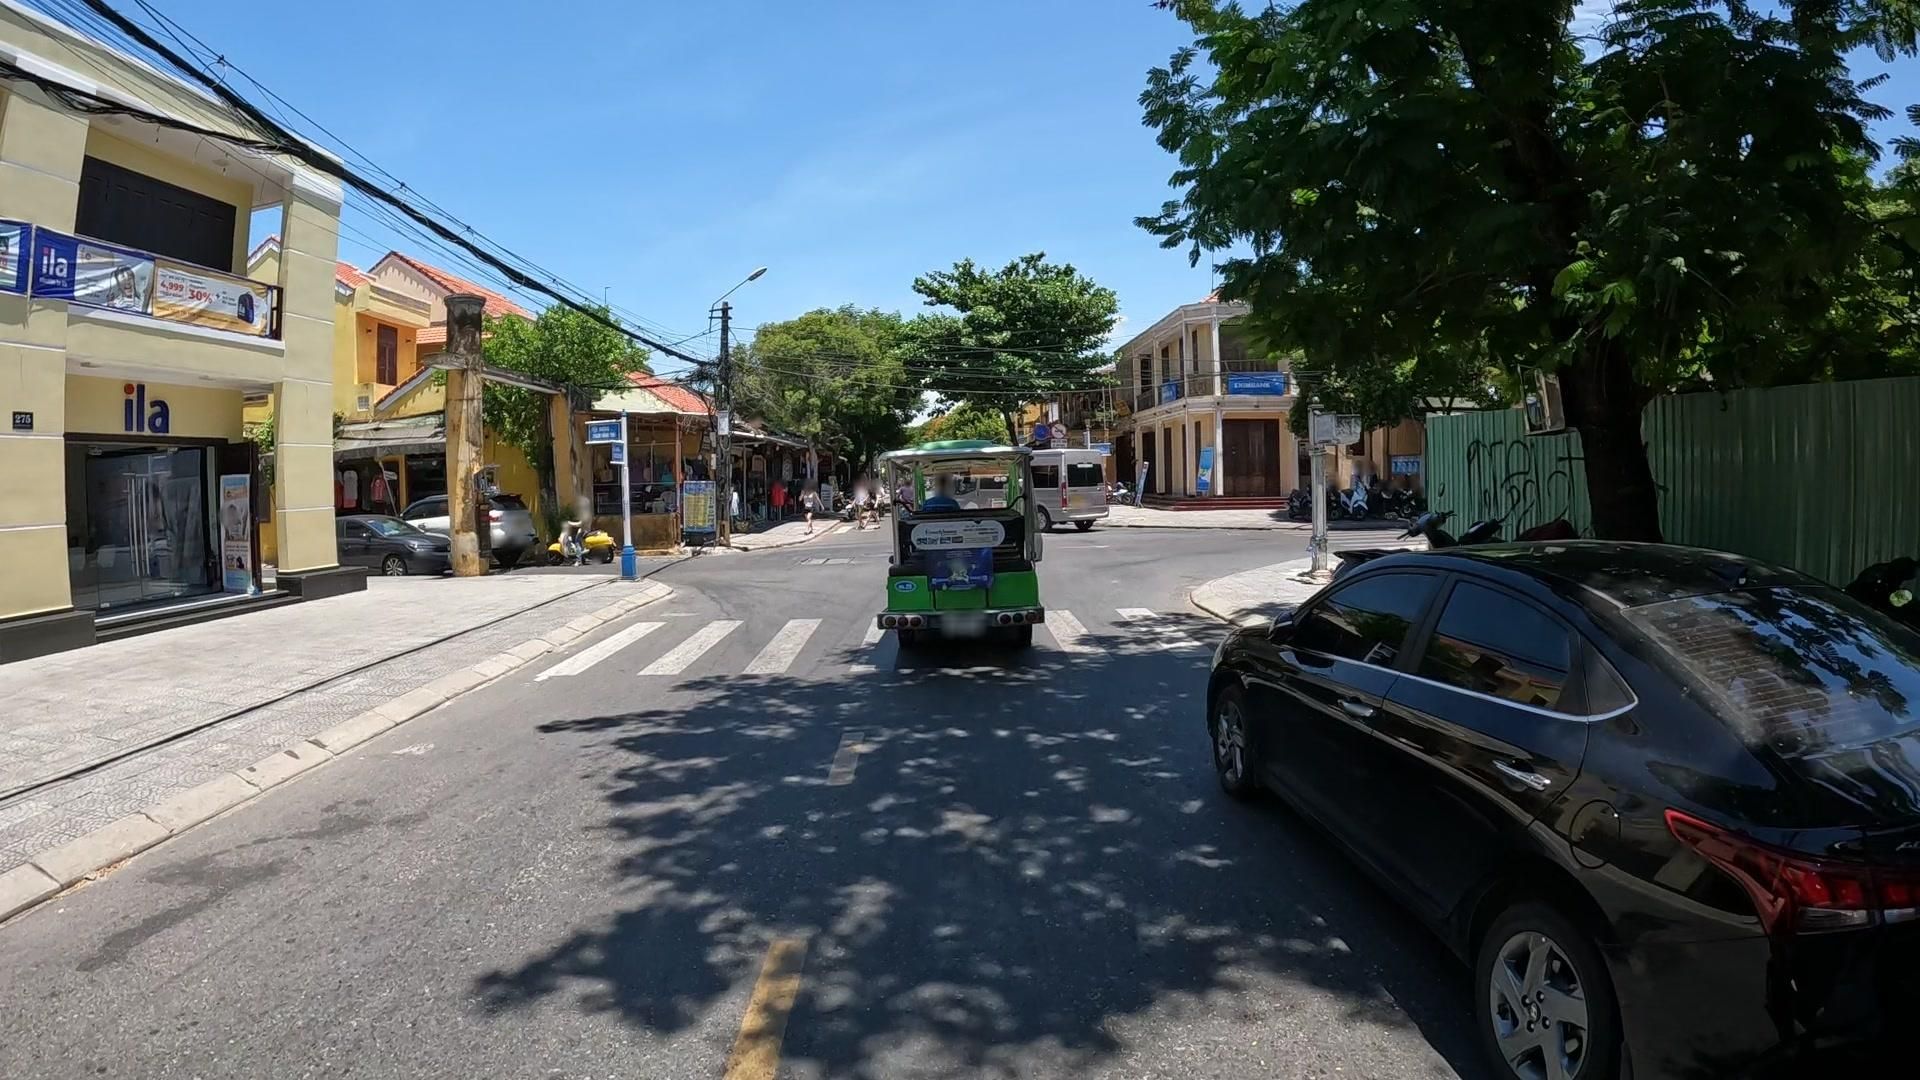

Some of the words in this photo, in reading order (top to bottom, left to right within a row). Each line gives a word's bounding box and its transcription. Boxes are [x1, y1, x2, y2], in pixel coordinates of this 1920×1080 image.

[42, 247, 68, 277] ila
[160, 280, 184, 292] 4,999
[188, 288, 213, 304] 30%
[123, 383, 170, 434] ila
[15, 415, 31, 424] 275
